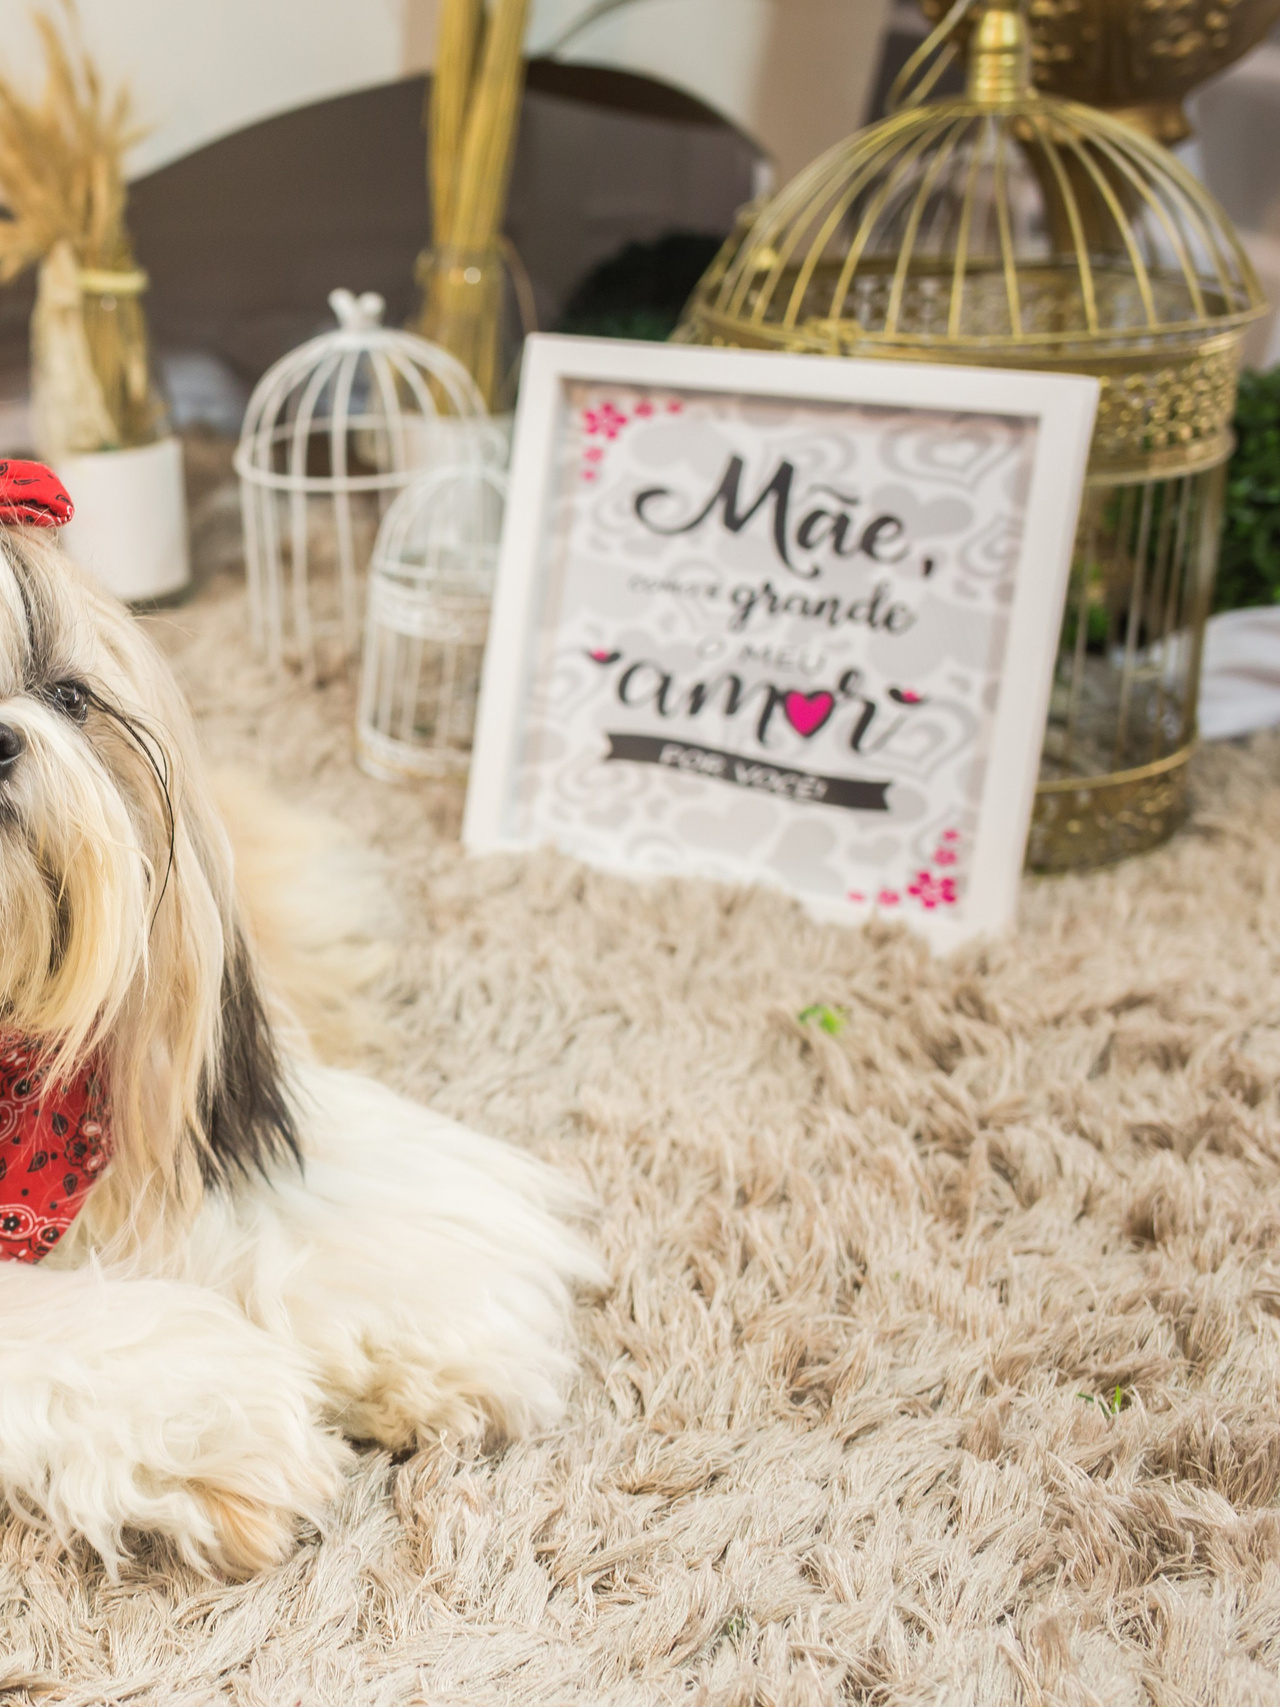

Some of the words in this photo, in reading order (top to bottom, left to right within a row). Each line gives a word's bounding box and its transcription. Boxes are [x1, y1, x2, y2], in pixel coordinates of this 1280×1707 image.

[634, 453, 935, 579] Mãe,
[729, 580, 917, 634] grande
[737, 643, 827, 677] MEU
